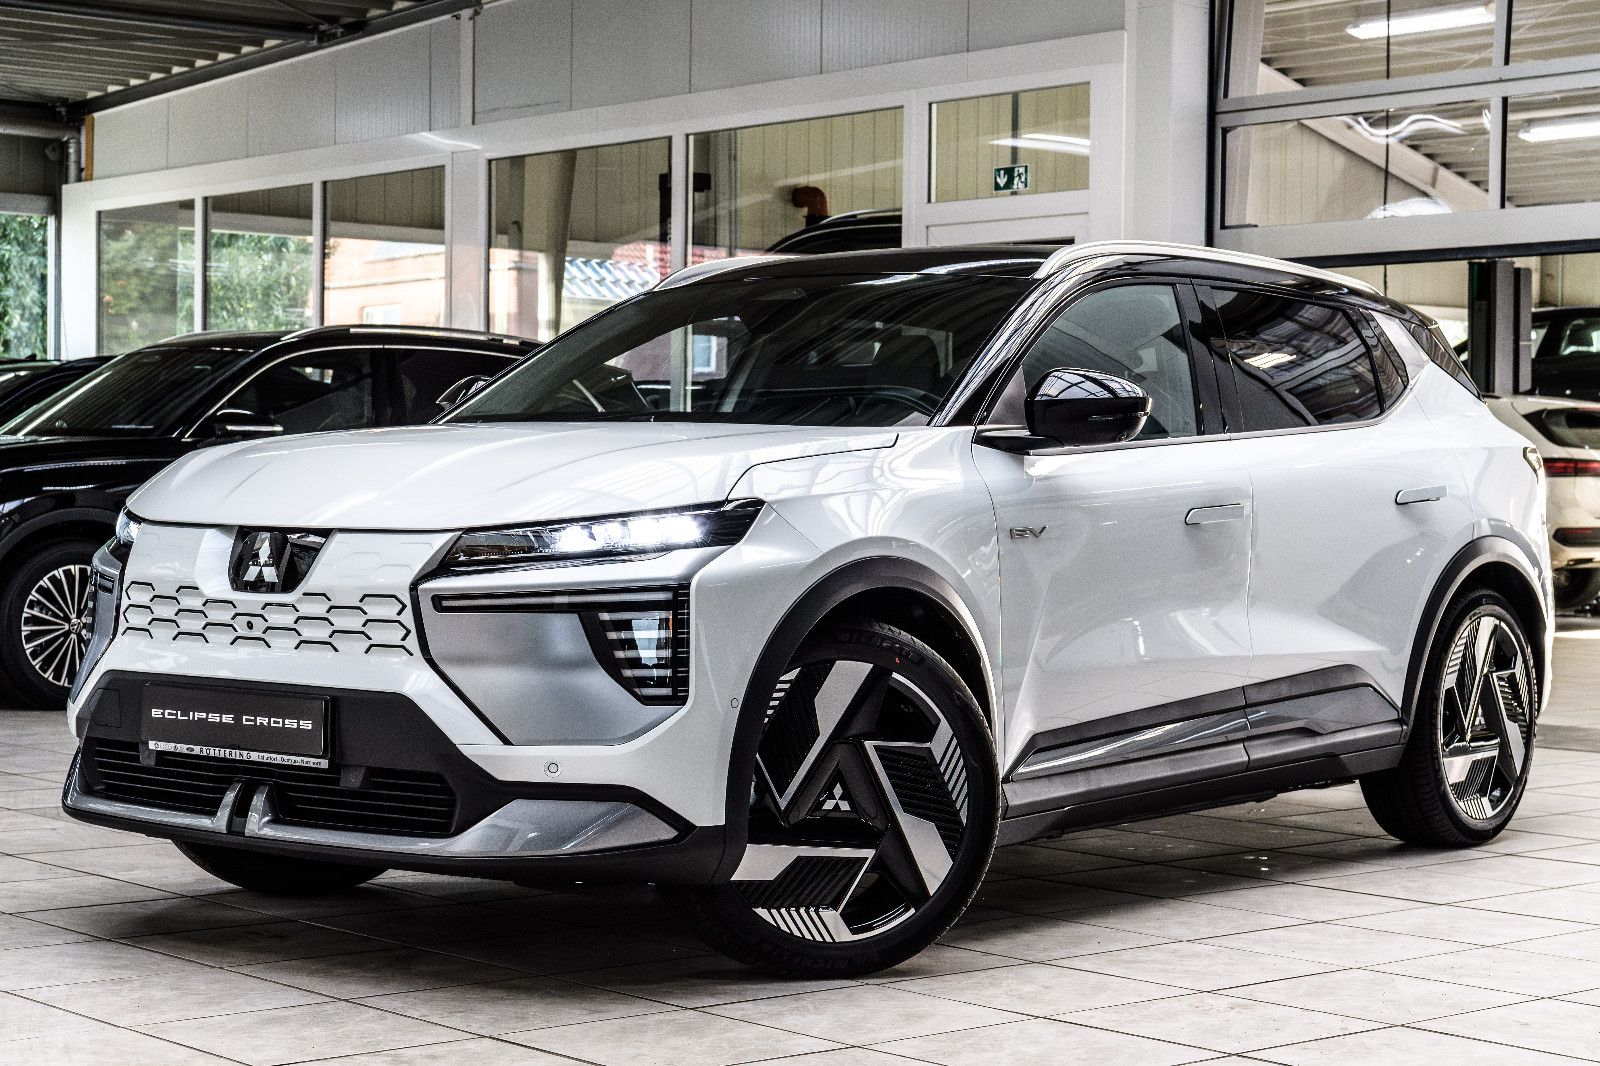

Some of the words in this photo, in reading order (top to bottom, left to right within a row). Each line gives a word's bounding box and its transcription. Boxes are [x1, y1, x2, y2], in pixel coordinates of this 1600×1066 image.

[1010, 525, 1048, 540] EV
[151, 708, 235, 724] ECLIPSE
[242, 715, 313, 730] CROSS
